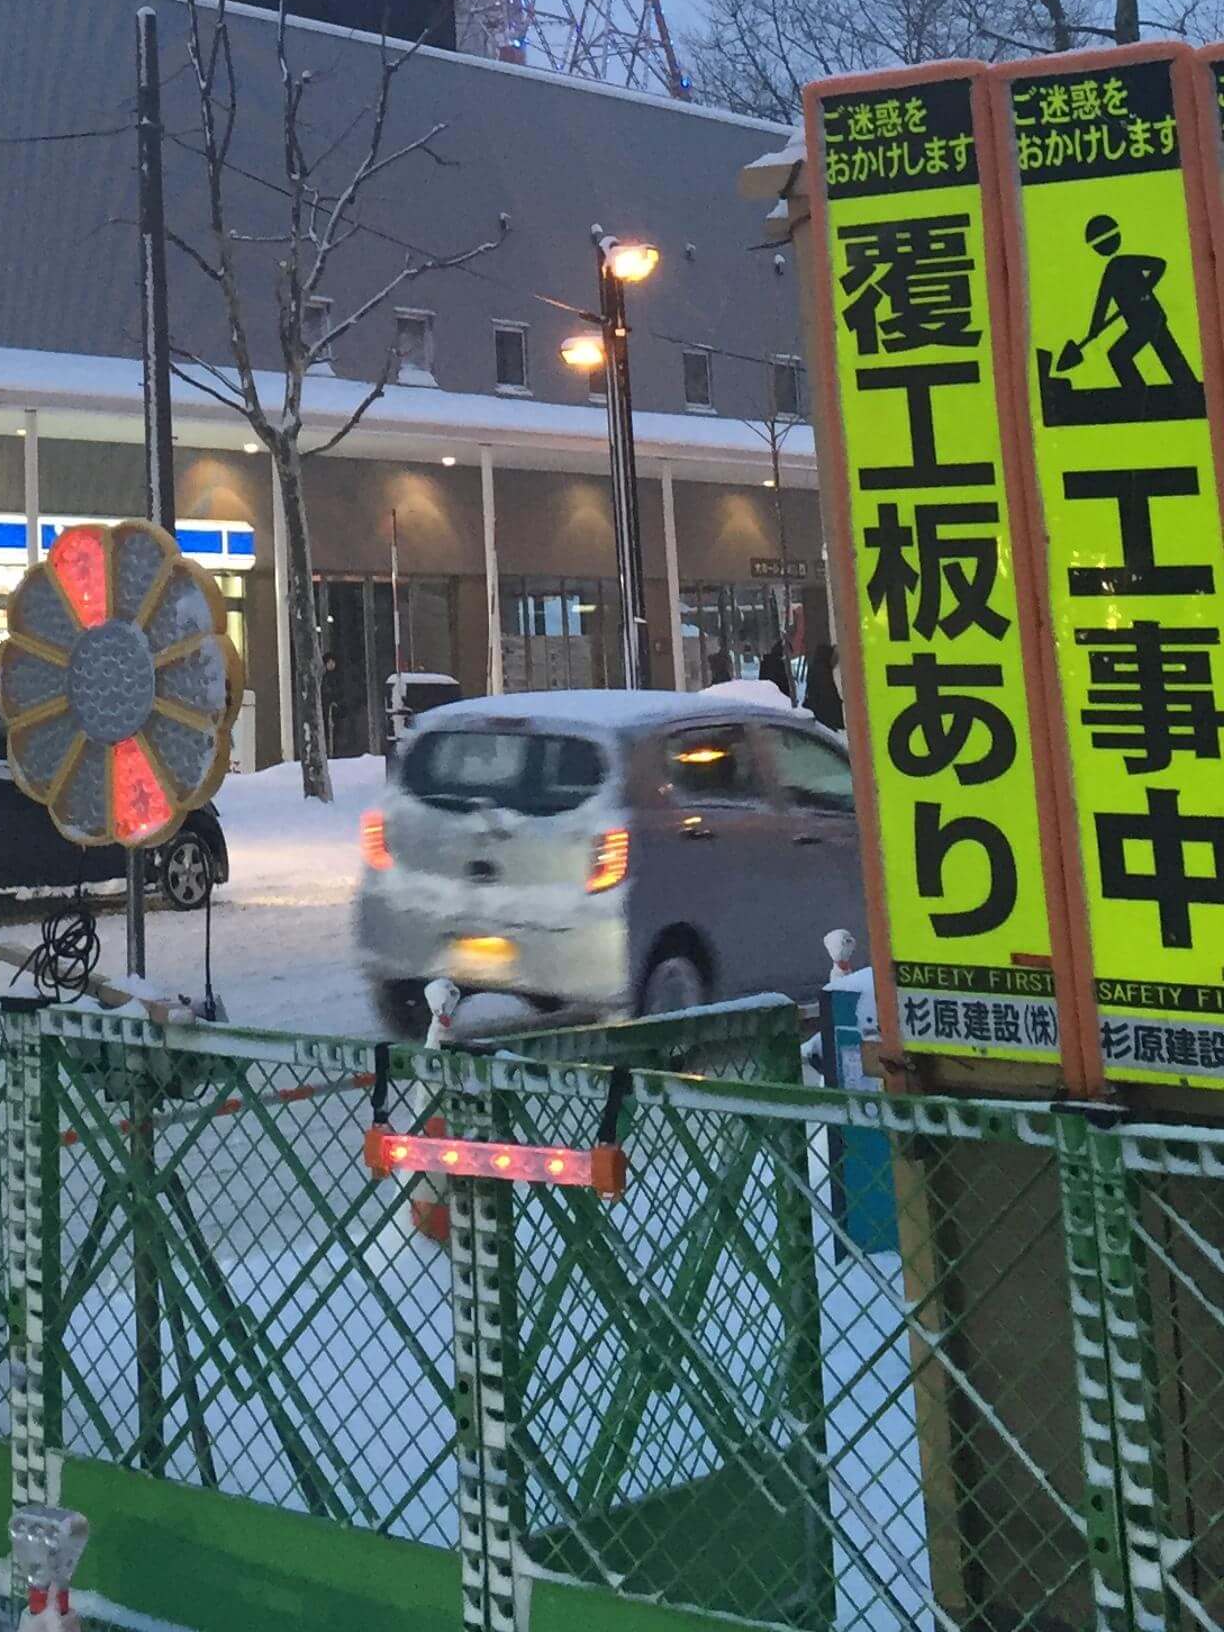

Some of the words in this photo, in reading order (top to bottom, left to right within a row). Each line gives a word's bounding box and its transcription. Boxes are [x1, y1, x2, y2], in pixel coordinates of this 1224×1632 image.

[823, 96, 928, 142] ご迷惑を
[1013, 76, 1129, 126] ご迷惑を
[825, 132, 975, 185] おかけします
[1017, 114, 1177, 170] おかけします
[836, 213, 1019, 938] 覆工板あり
[1062, 465, 1224, 949] 工事中
[898, 965, 975, 987] SAFETY
[988, 970, 1055, 993] FIRST
[1098, 981, 1182, 1006] SAFETY
